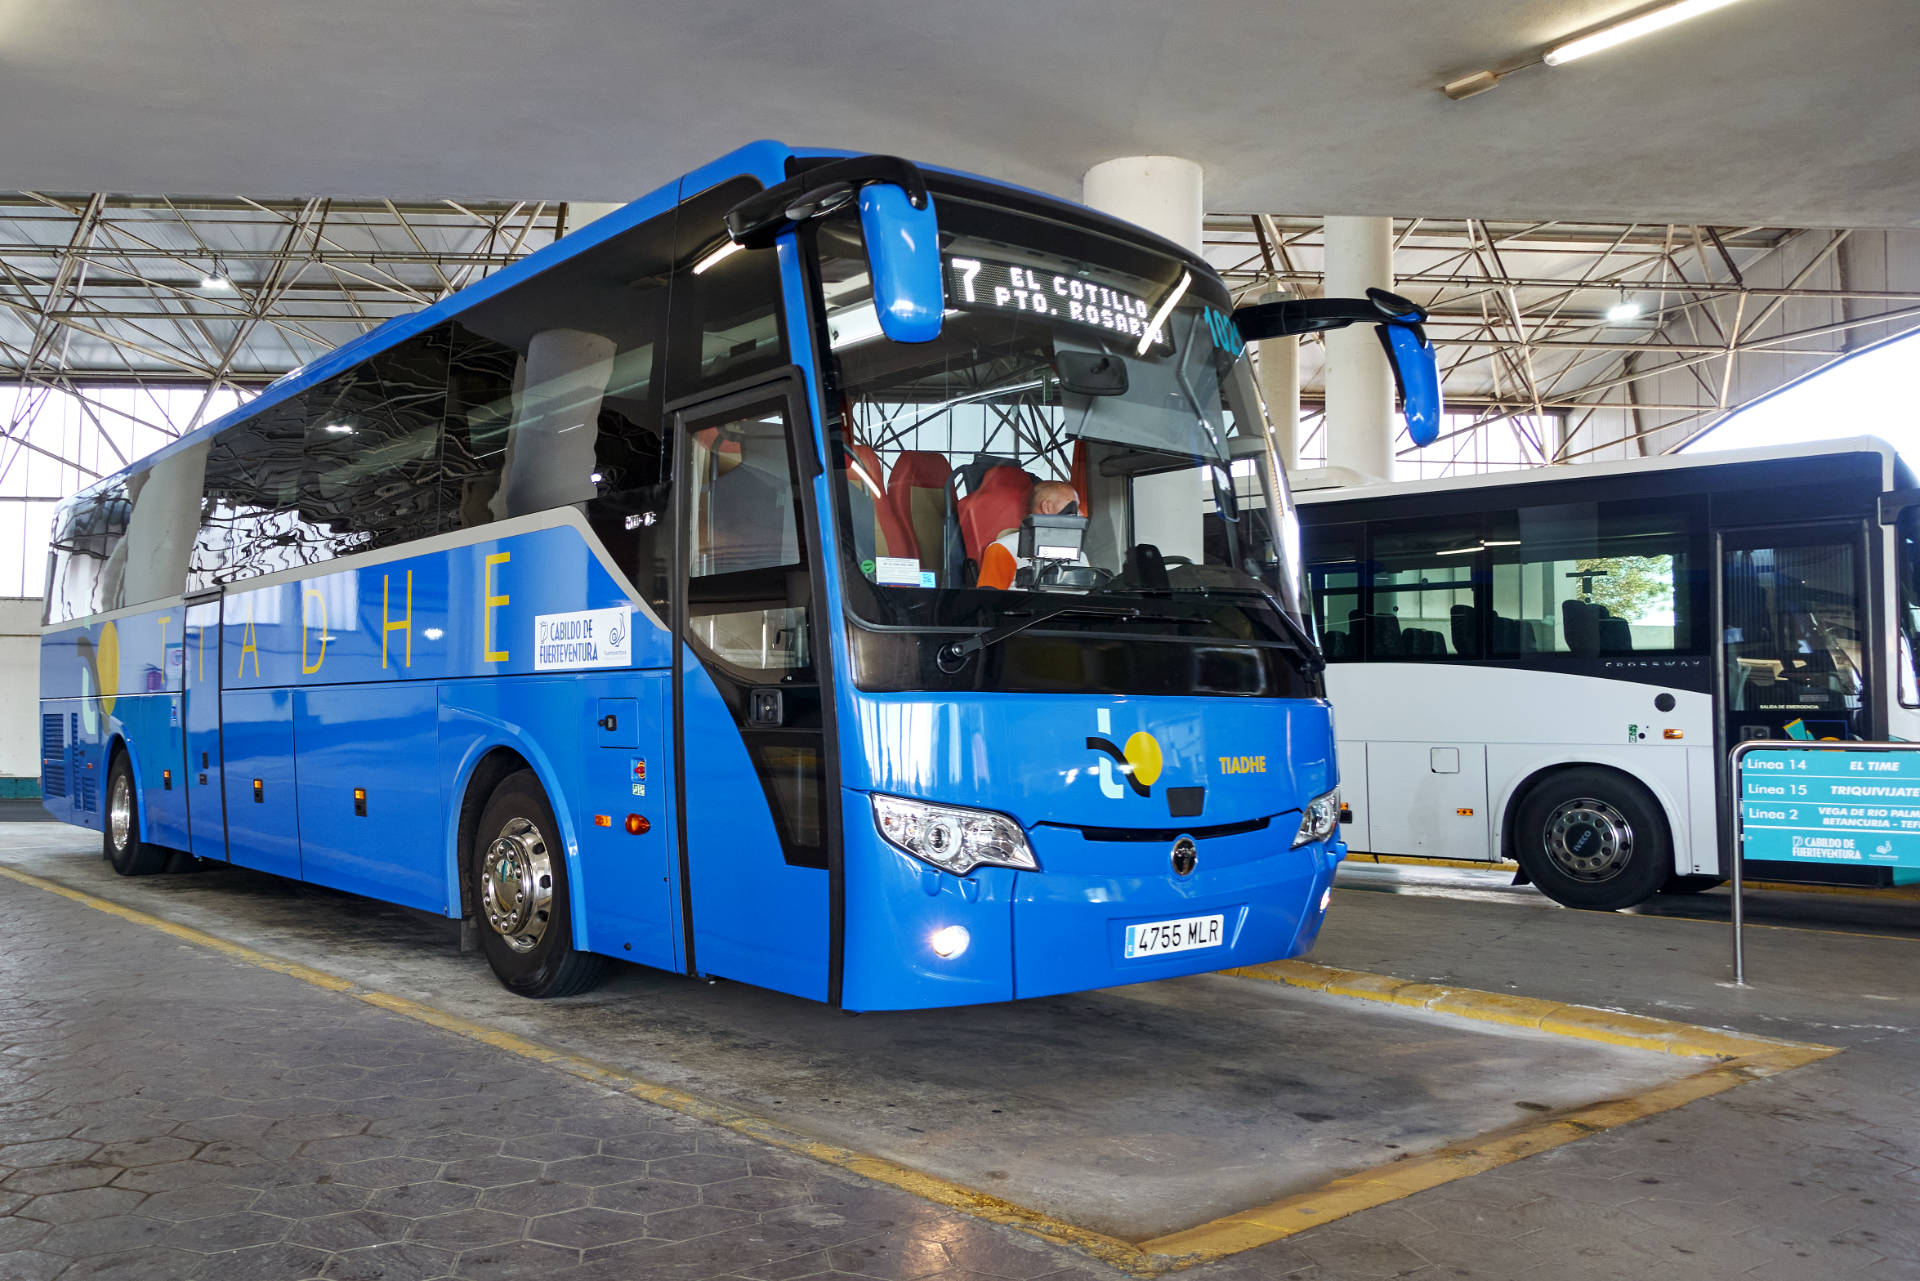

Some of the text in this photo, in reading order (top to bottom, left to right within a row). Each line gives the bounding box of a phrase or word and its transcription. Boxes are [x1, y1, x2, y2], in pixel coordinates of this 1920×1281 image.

[951, 258, 981, 303] 7
[1010, 267, 1149, 320] EL COTILLO
[994, 286, 1058, 316] PTO.
[158, 552, 512, 684] TIADHE
[550, 619, 593, 642] CABILDO DE
[540, 642, 599, 664] FUERTEVENTURA
[1218, 755, 1267, 775] TIADHE
[1789, 759, 1807, 770] 14
[1849, 761, 1900, 772] EL TIME
[1790, 784, 1808, 796] 15
[1830, 785, 1920, 797] TRIQUIVIJATE
[1789, 809, 1799, 820] 2
[1818, 807, 1848, 816] VEGA
[1850, 808, 1865, 817] DE
[1822, 817, 1890, 828] BETANCURIA
[1804, 837, 1856, 849] CABILDO DE
[1792, 847, 1862, 860] FUERTEVENTURA
[1139, 919, 1219, 952] 4755 MLR
